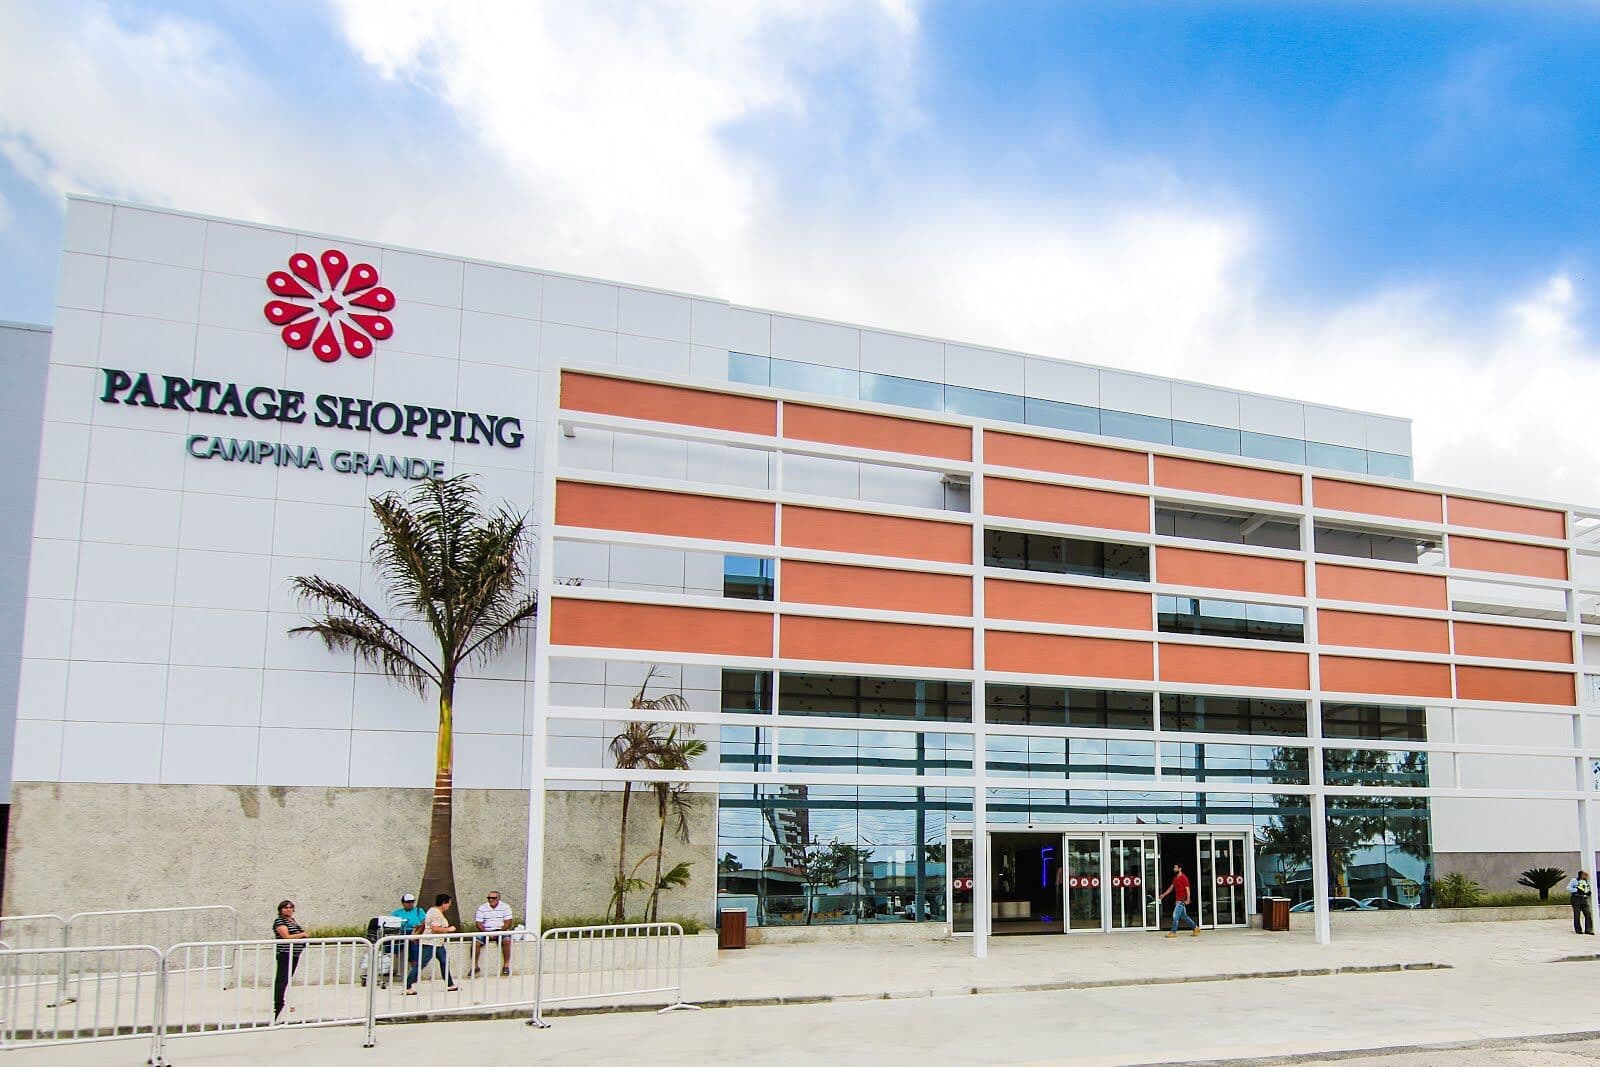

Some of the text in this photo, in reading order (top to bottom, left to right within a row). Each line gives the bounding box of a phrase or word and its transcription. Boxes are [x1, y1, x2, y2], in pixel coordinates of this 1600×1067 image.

[100, 367, 525, 448] PARTAGE SHOPPING
[186, 434, 445, 480] CAMPINA GRANDE
